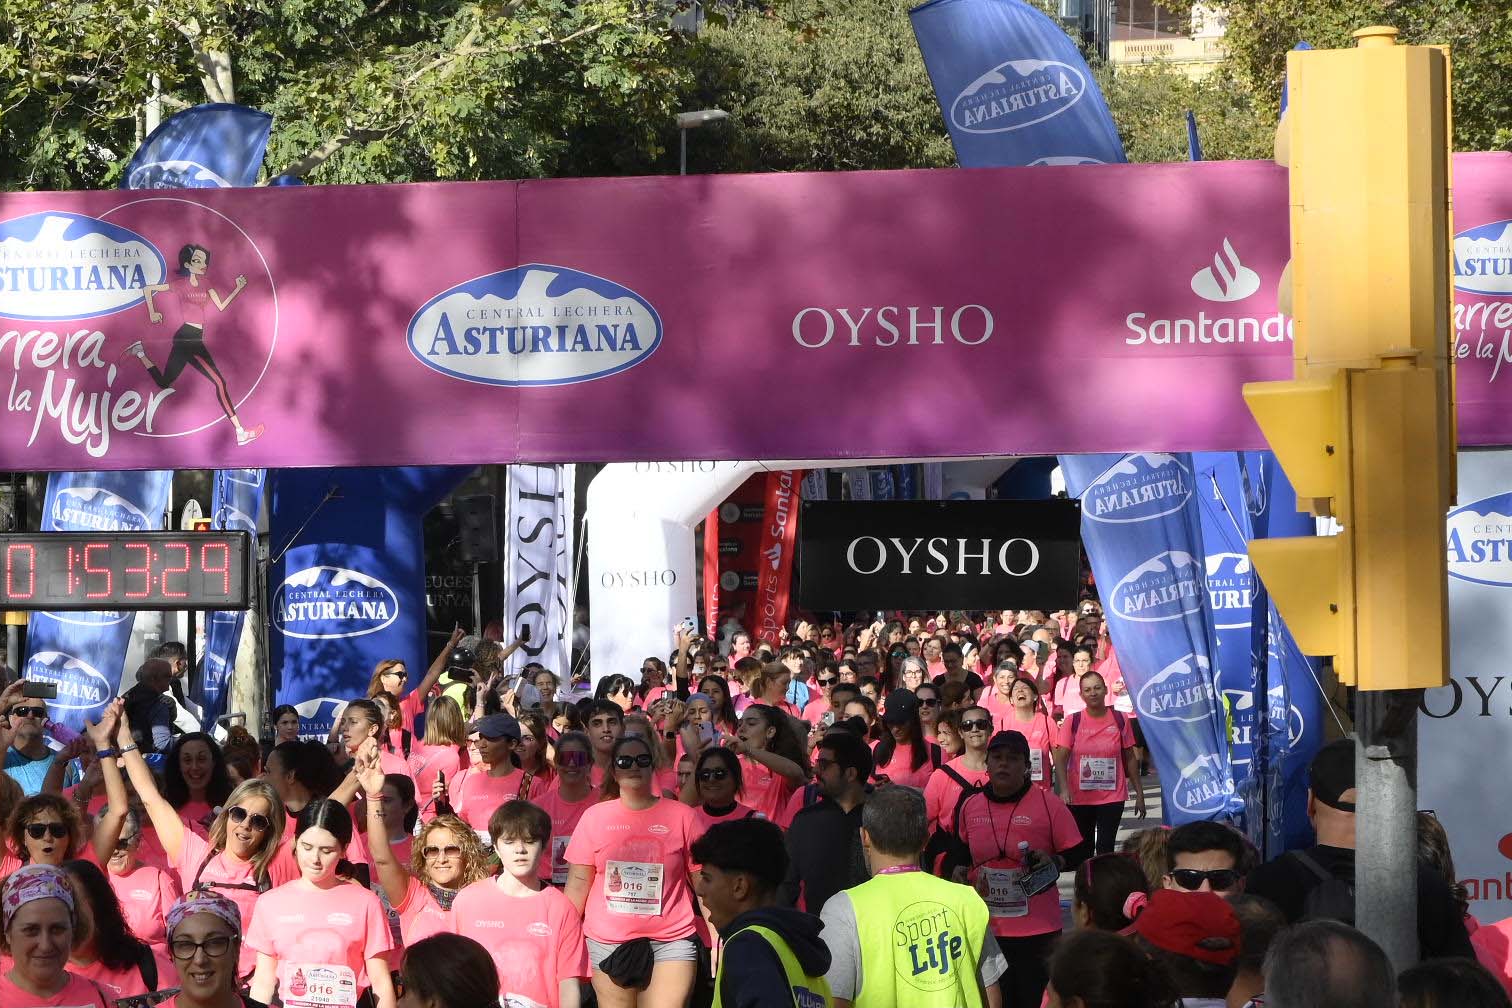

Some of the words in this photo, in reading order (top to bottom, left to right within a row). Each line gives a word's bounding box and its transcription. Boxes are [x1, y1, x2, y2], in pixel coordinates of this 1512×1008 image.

[69, 246, 141, 259] LECHERA
[466, 306, 545, 320] CENTRAL
[552, 304, 634, 319] LECHERA
[791, 304, 995, 348] OYSHO
[1124, 311, 1294, 345] Santand
[427, 311, 643, 356] ASTURIANA
[7, 373, 32, 412] la
[27, 363, 176, 458] Mujer
[6, 542, 230, 599] 01:53:29
[846, 535, 1040, 577] OYSHO
[276, 593, 389, 623] ASTURIANA
[289, 590, 331, 599] CENTRAL
[758, 575, 778, 642] Sports
[623, 882, 643, 891] 016
[990, 887, 1008, 895] 016
[895, 907, 951, 947] Sport
[908, 930, 962, 977] Life
[309, 984, 334, 995] 016
